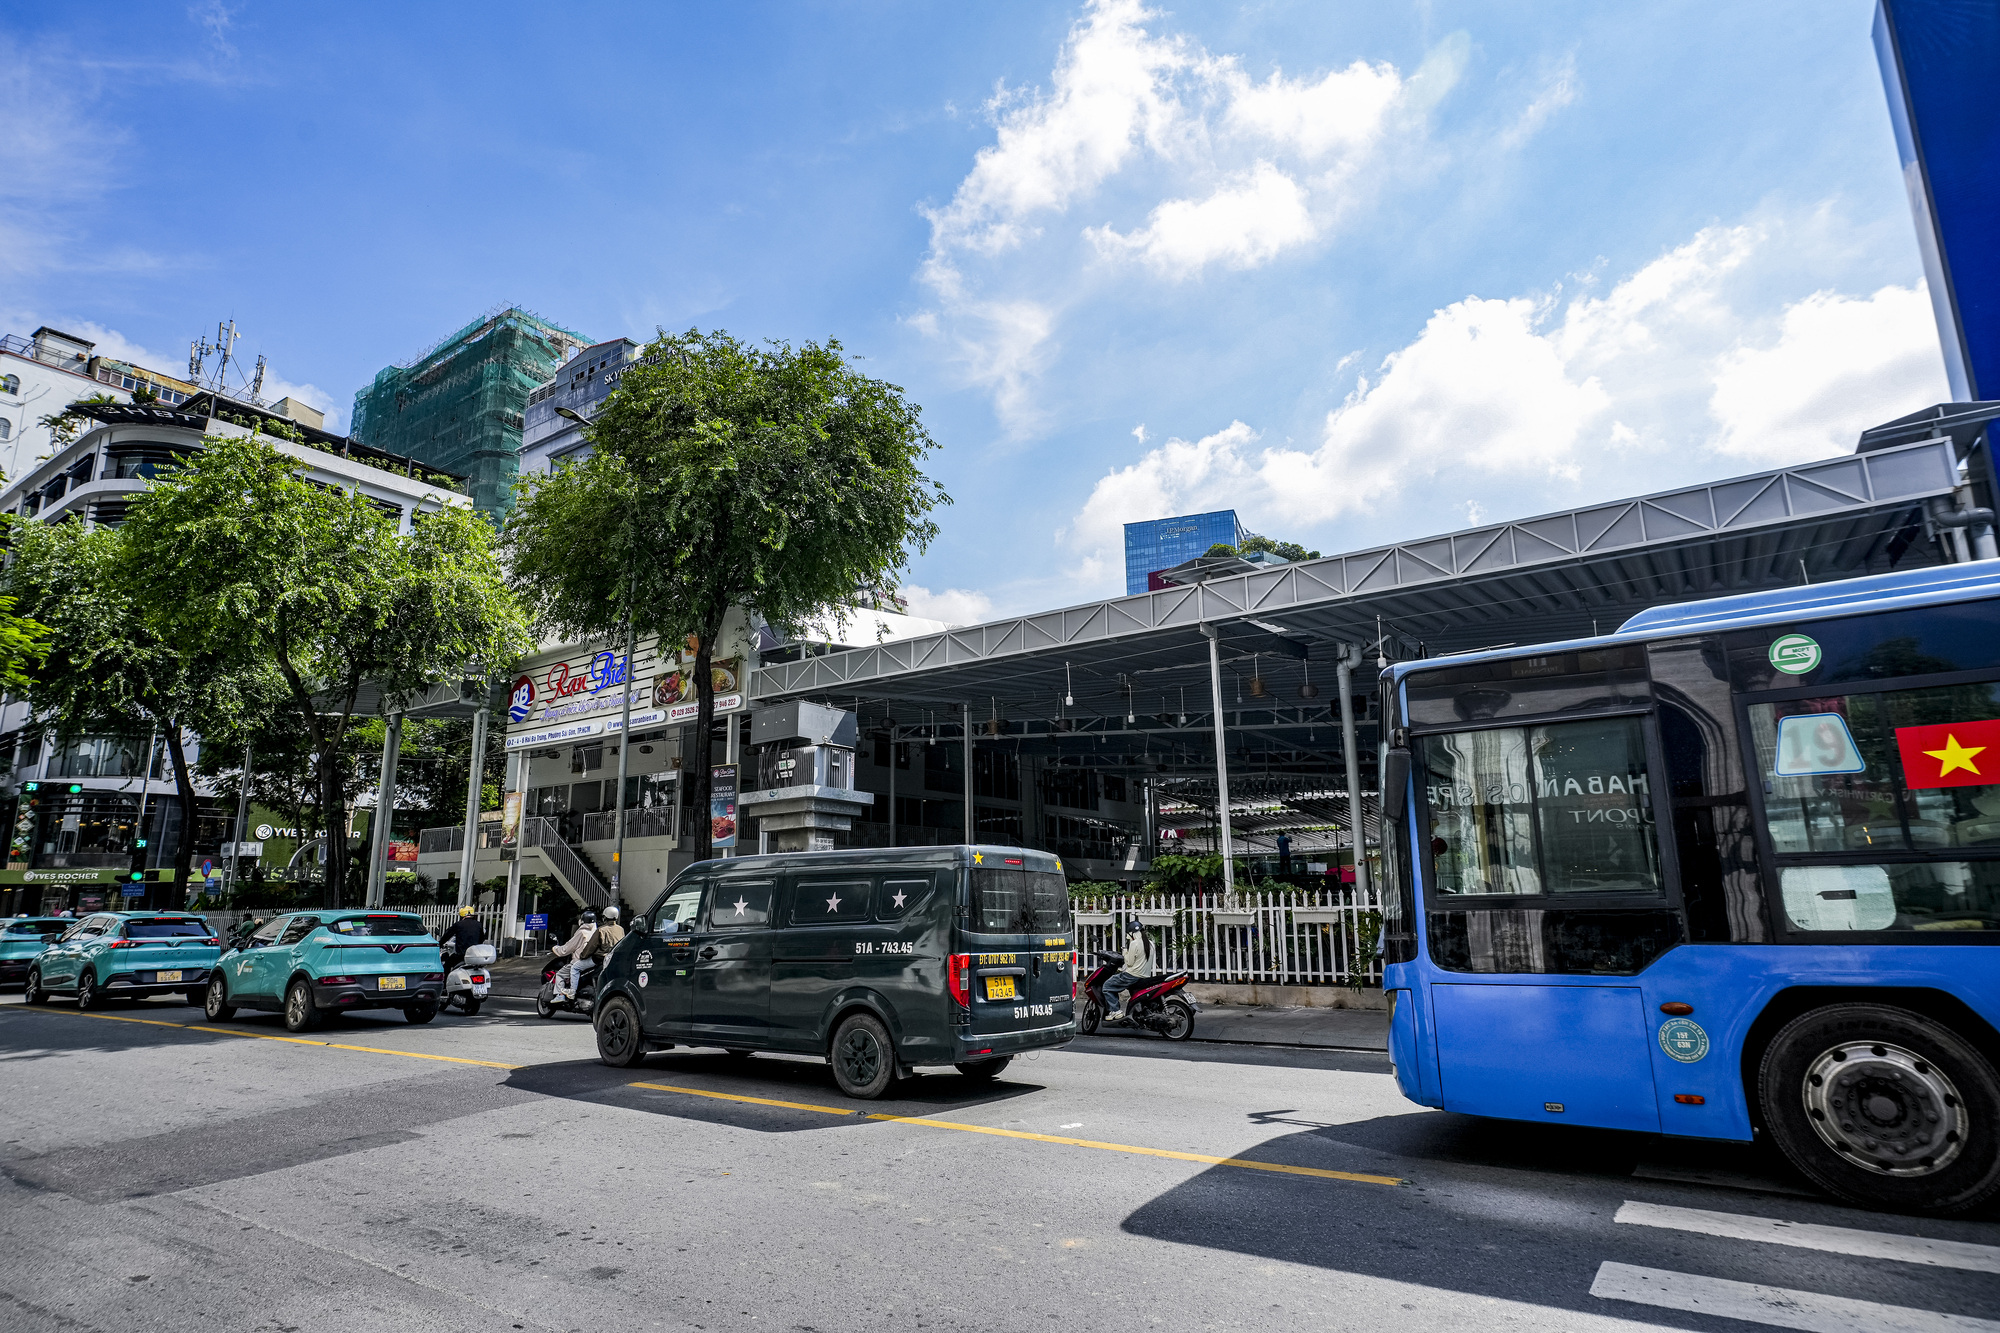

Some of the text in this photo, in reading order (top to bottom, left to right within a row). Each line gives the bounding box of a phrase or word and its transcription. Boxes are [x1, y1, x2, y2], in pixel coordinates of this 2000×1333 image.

[546, 663, 588, 704] Rạn
[1783, 722, 1847, 769] 19
[26, 782, 38, 791] 34
[136, 840, 147, 848] 34
[57, 872, 98, 880] ROCHER
[855, 942, 873, 954] 51A
[881, 941, 913, 954] 743.45
[994, 977, 1007, 987] 51A
[990, 987, 1013, 999] 743.45
[1014, 1004, 1053, 1019] 51A 743.45
